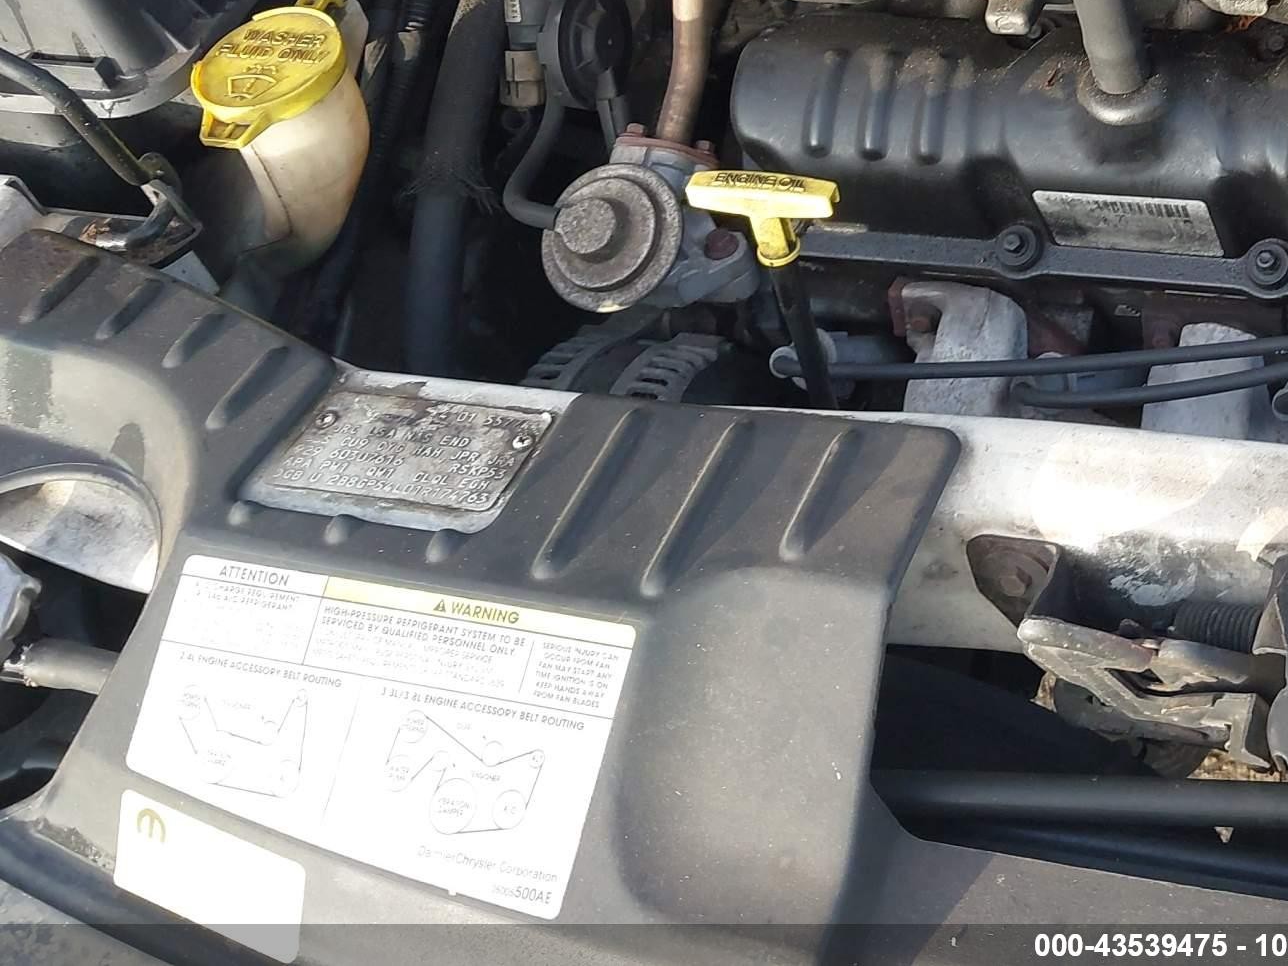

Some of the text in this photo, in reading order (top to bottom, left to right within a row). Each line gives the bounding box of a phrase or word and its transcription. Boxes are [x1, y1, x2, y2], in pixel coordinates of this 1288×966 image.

[243, 28, 327, 49] WASHER
[216, 42, 330, 64] FLUID ONLY
[714, 172, 807, 191] ENGINE OIL
[309, 471, 322, 483] U
[219, 565, 290, 586] ATTENTION
[451, 601, 520, 624] WARNING
[322, 617, 515, 656] SERVICED BY QUALIFIED PERSONNEL ONLY
[324, 605, 526, 647] HIGH-PRESSURE REFRIGERANT SYSTEM TO BE
[198, 655, 228, 668] ENGINE
[229, 660, 281, 676] ACCESSORY
[283, 669, 301, 681] BELT
[303, 673, 343, 688] ROUTING
[424, 694, 458, 708] ENGINE
[460, 702, 516, 720] ACCESSORY
[520, 709, 539, 722] BELT
[541, 714, 584, 731] ROUTING
